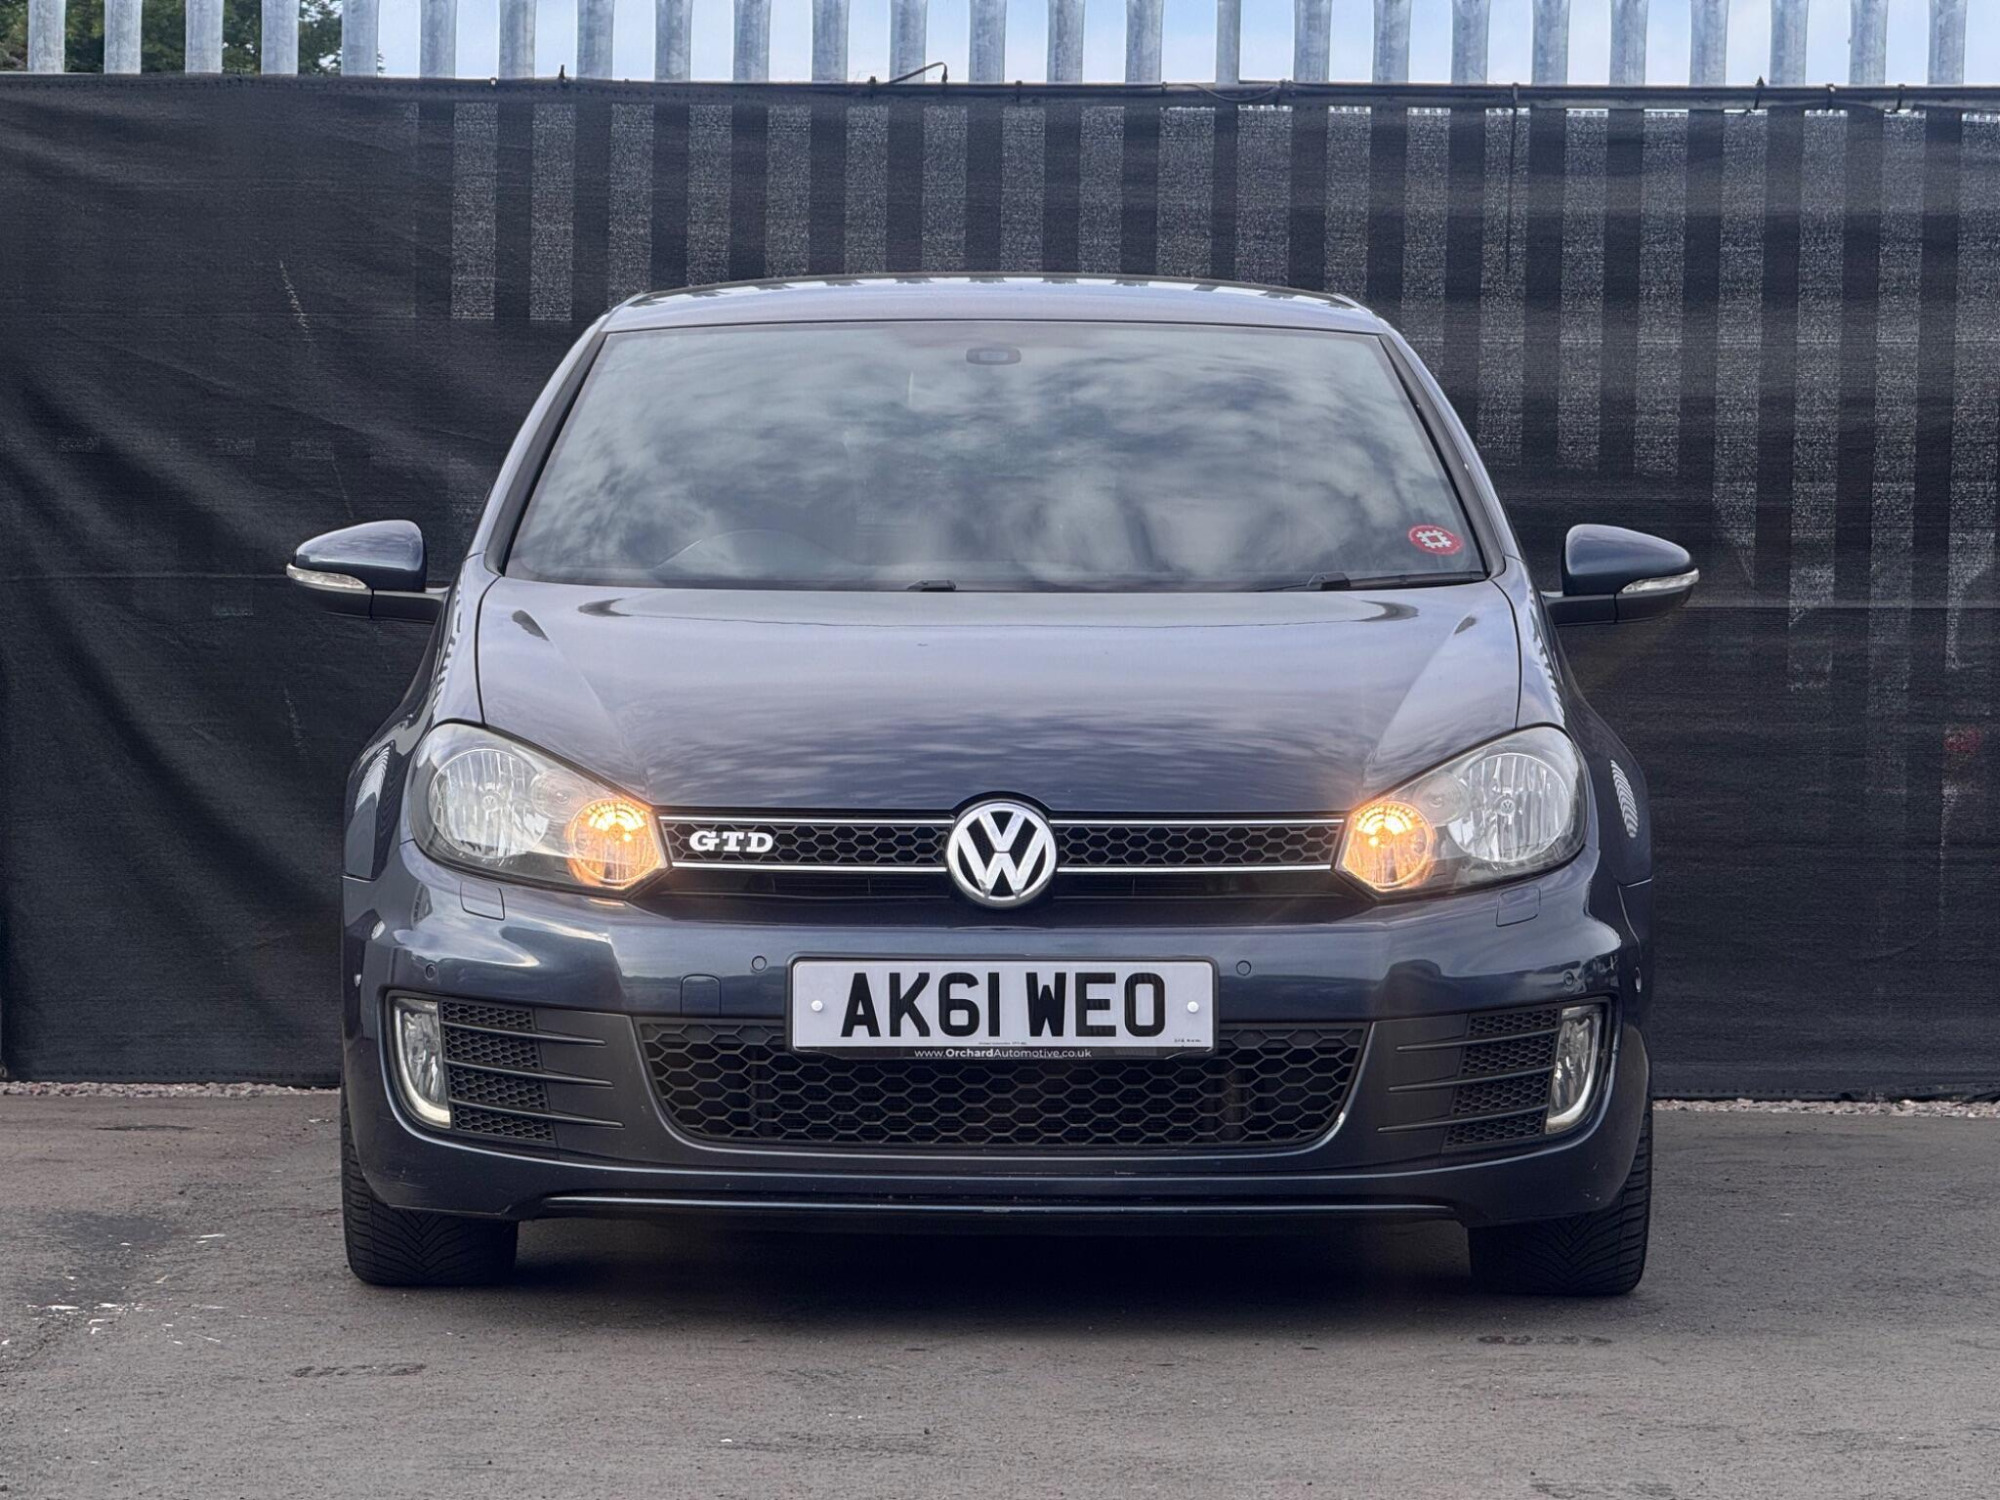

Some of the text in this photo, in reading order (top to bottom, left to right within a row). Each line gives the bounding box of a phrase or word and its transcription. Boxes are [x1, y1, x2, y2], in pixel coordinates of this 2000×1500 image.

[689, 830, 774, 853] GTD
[952, 807, 1051, 900] VW
[841, 972, 1166, 1037] AK61 WEO
[914, 1048, 1092, 1058] www.OrchardAutomotive.co.uk
